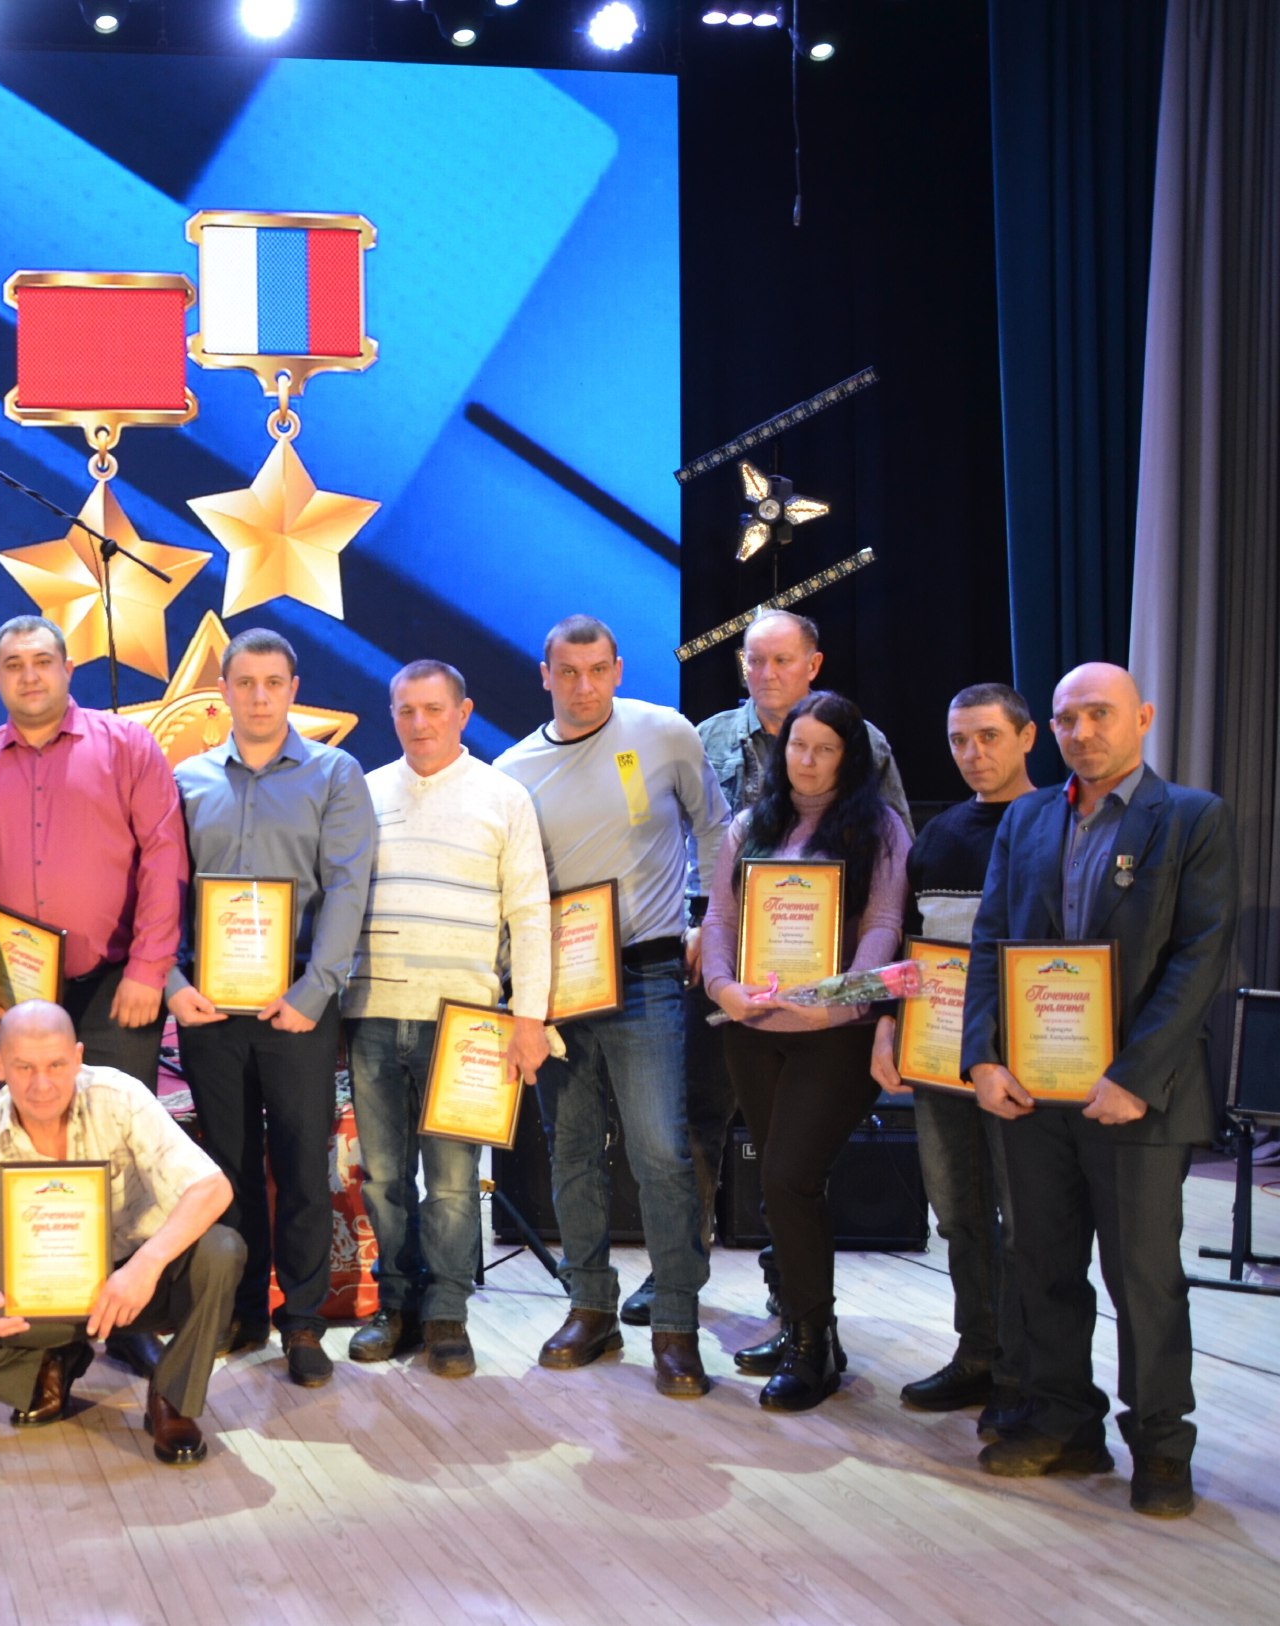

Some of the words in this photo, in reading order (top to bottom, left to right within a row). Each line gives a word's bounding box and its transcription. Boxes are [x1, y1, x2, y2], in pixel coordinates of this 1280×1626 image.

[763, 897, 819, 912] Почетная
[770, 912, 814, 926] грамота
[1025, 985, 1090, 1002] Почетная
[1034, 1003, 1085, 1018] грамота
